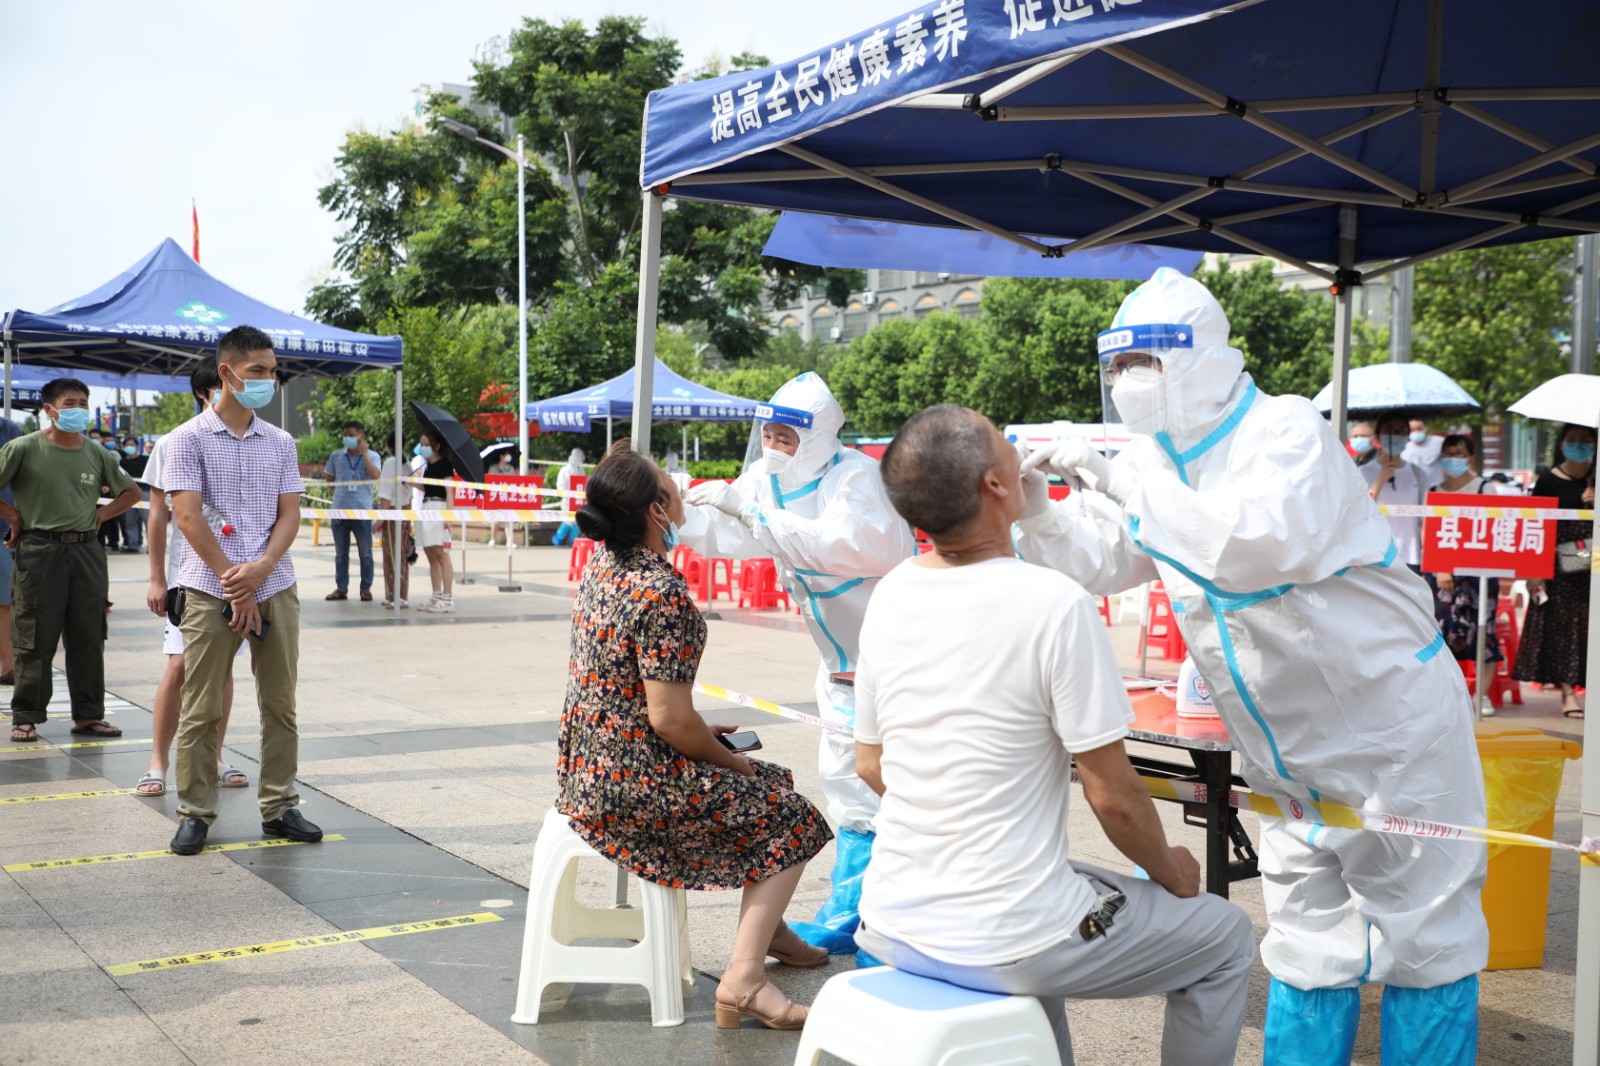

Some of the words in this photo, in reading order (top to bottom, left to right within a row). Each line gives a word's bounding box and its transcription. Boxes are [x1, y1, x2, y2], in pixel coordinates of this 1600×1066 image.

[709, 0, 969, 145] 提高全民健康素养
[1436, 514, 1545, 554] 县卫健局
